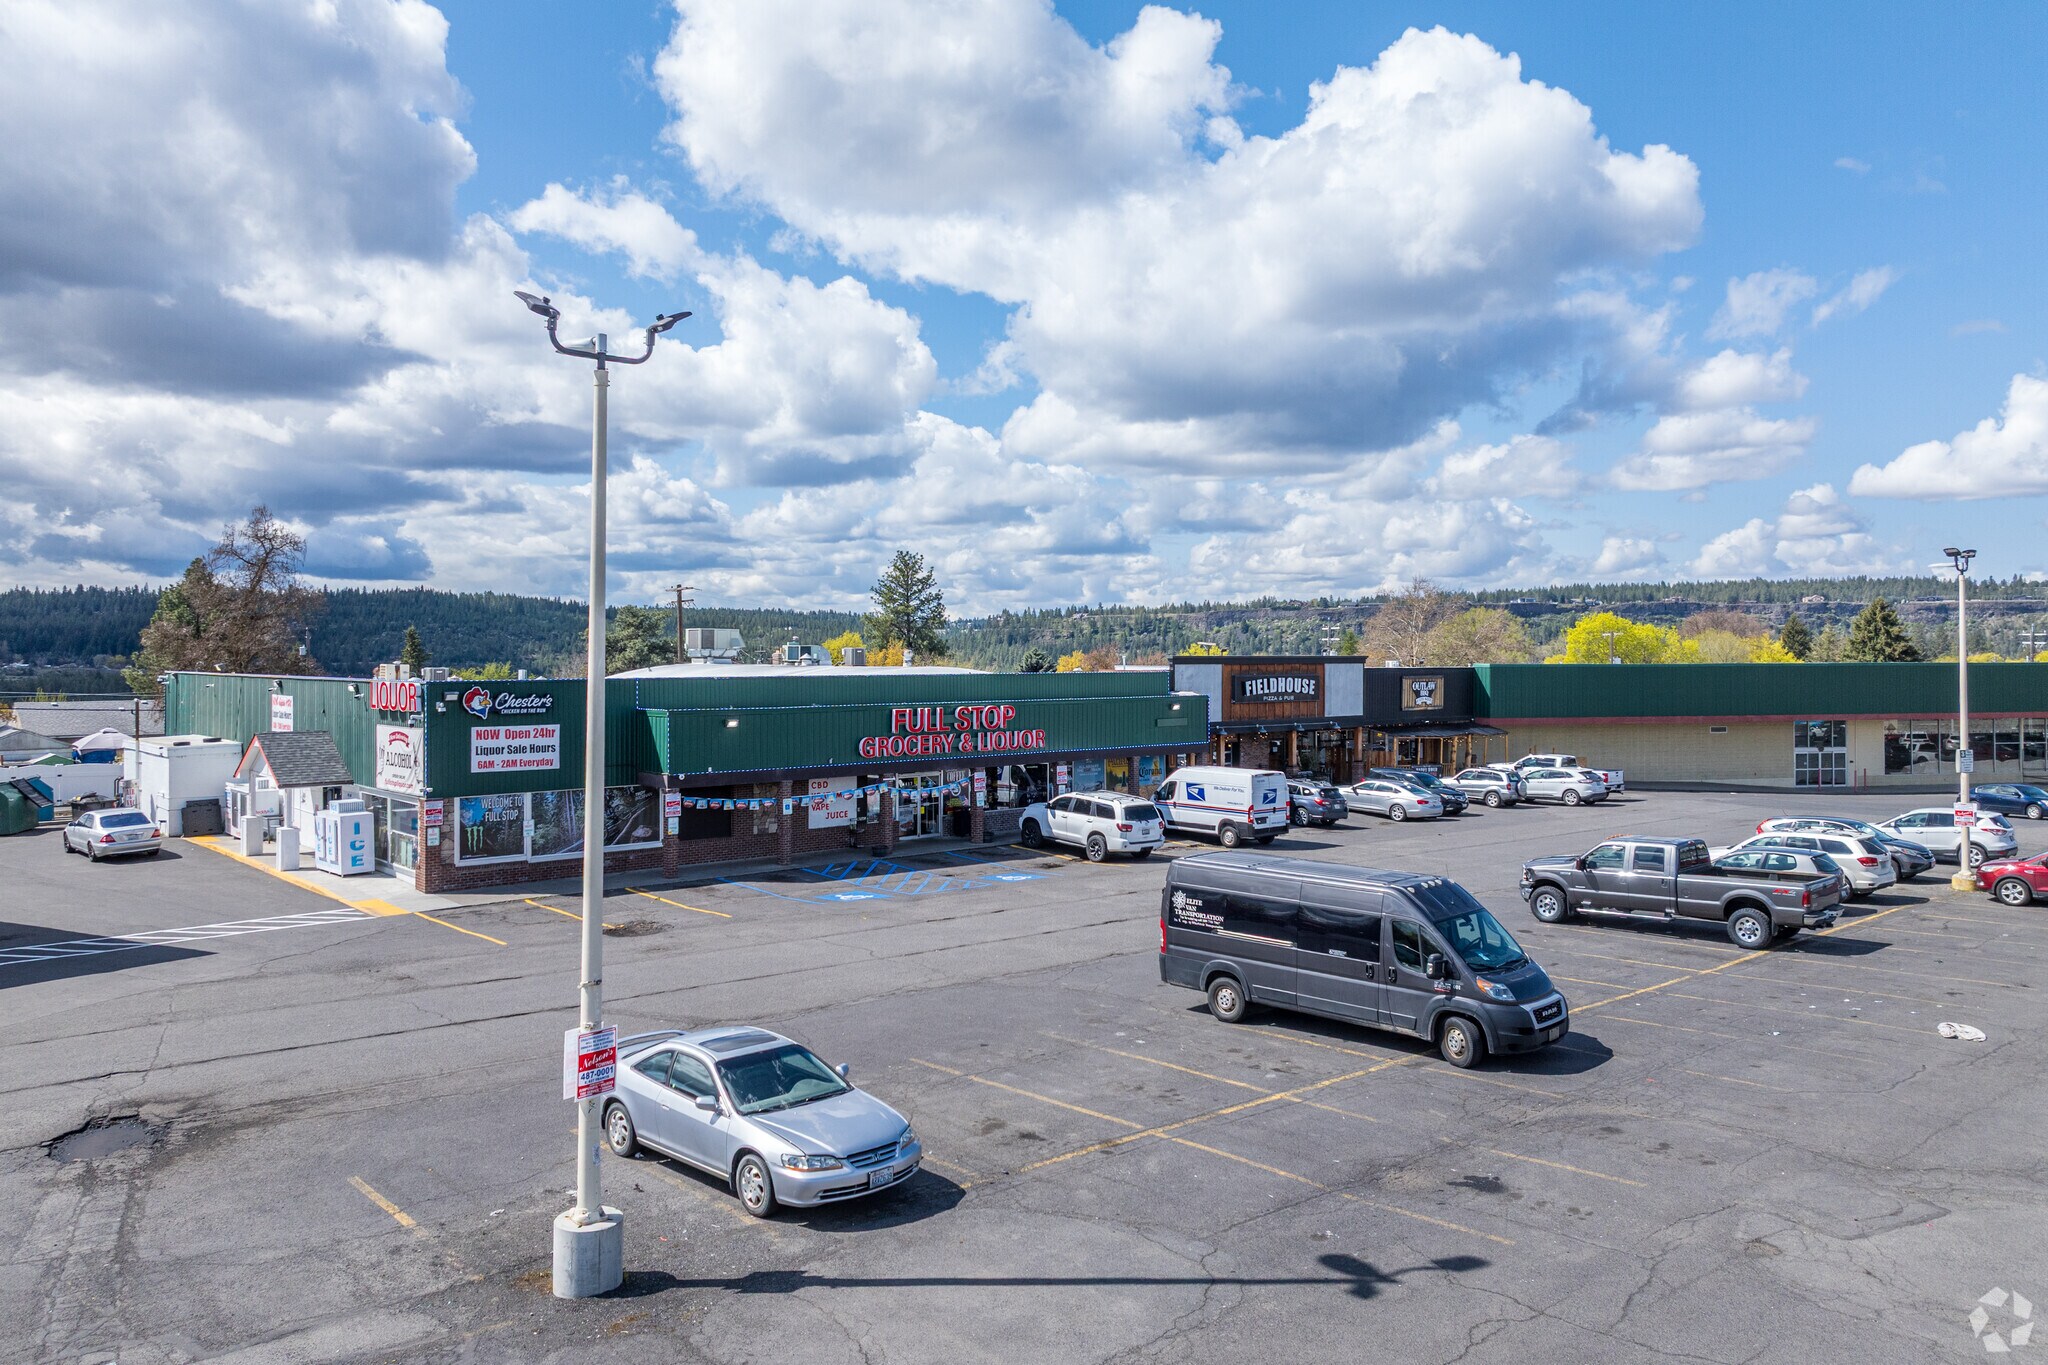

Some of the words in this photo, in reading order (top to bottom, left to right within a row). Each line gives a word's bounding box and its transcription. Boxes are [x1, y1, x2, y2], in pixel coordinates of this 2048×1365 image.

[1245, 677, 1315, 696] FIELDHOUSE
[1412, 681, 1436, 690] OUTLAW
[370, 681, 417, 712] LIQUOR
[495, 692, 553, 709] Chester's
[892, 707, 949, 733] FULL
[954, 705, 1015, 731] STOP
[475, 729, 500, 741] NOW
[505, 728, 530, 740] Open
[533, 727, 556, 739] 24hr
[475, 745, 505, 756] Liquor
[507, 744, 527, 754] Sale
[529, 743, 556, 754] Hours
[859, 733, 955, 758] GROCERY
[959, 733, 973, 752] &
[977, 729, 1046, 752] LIQUOR
[477, 760, 495, 769] 6AM
[501, 759, 517, 768] 2AM
[519, 758, 554, 768] Everyday
[811, 781, 828, 789] CBD
[481, 797, 513, 809] WELCOME
[515, 796, 523, 806] TO
[485, 811, 501, 822] FULL
[502, 810, 519, 821] STOP
[825, 811, 848, 819] JUICE
[349, 821, 365, 867] ICE
[1186, 898, 1203, 906] ELITE
[1175, 909, 1224, 922] TRANSPORTATION
[580, 1048, 614, 1071] Nelson's
[595, 1060, 613, 1068] TOWING
[581, 1065, 614, 1080] 487-0001
